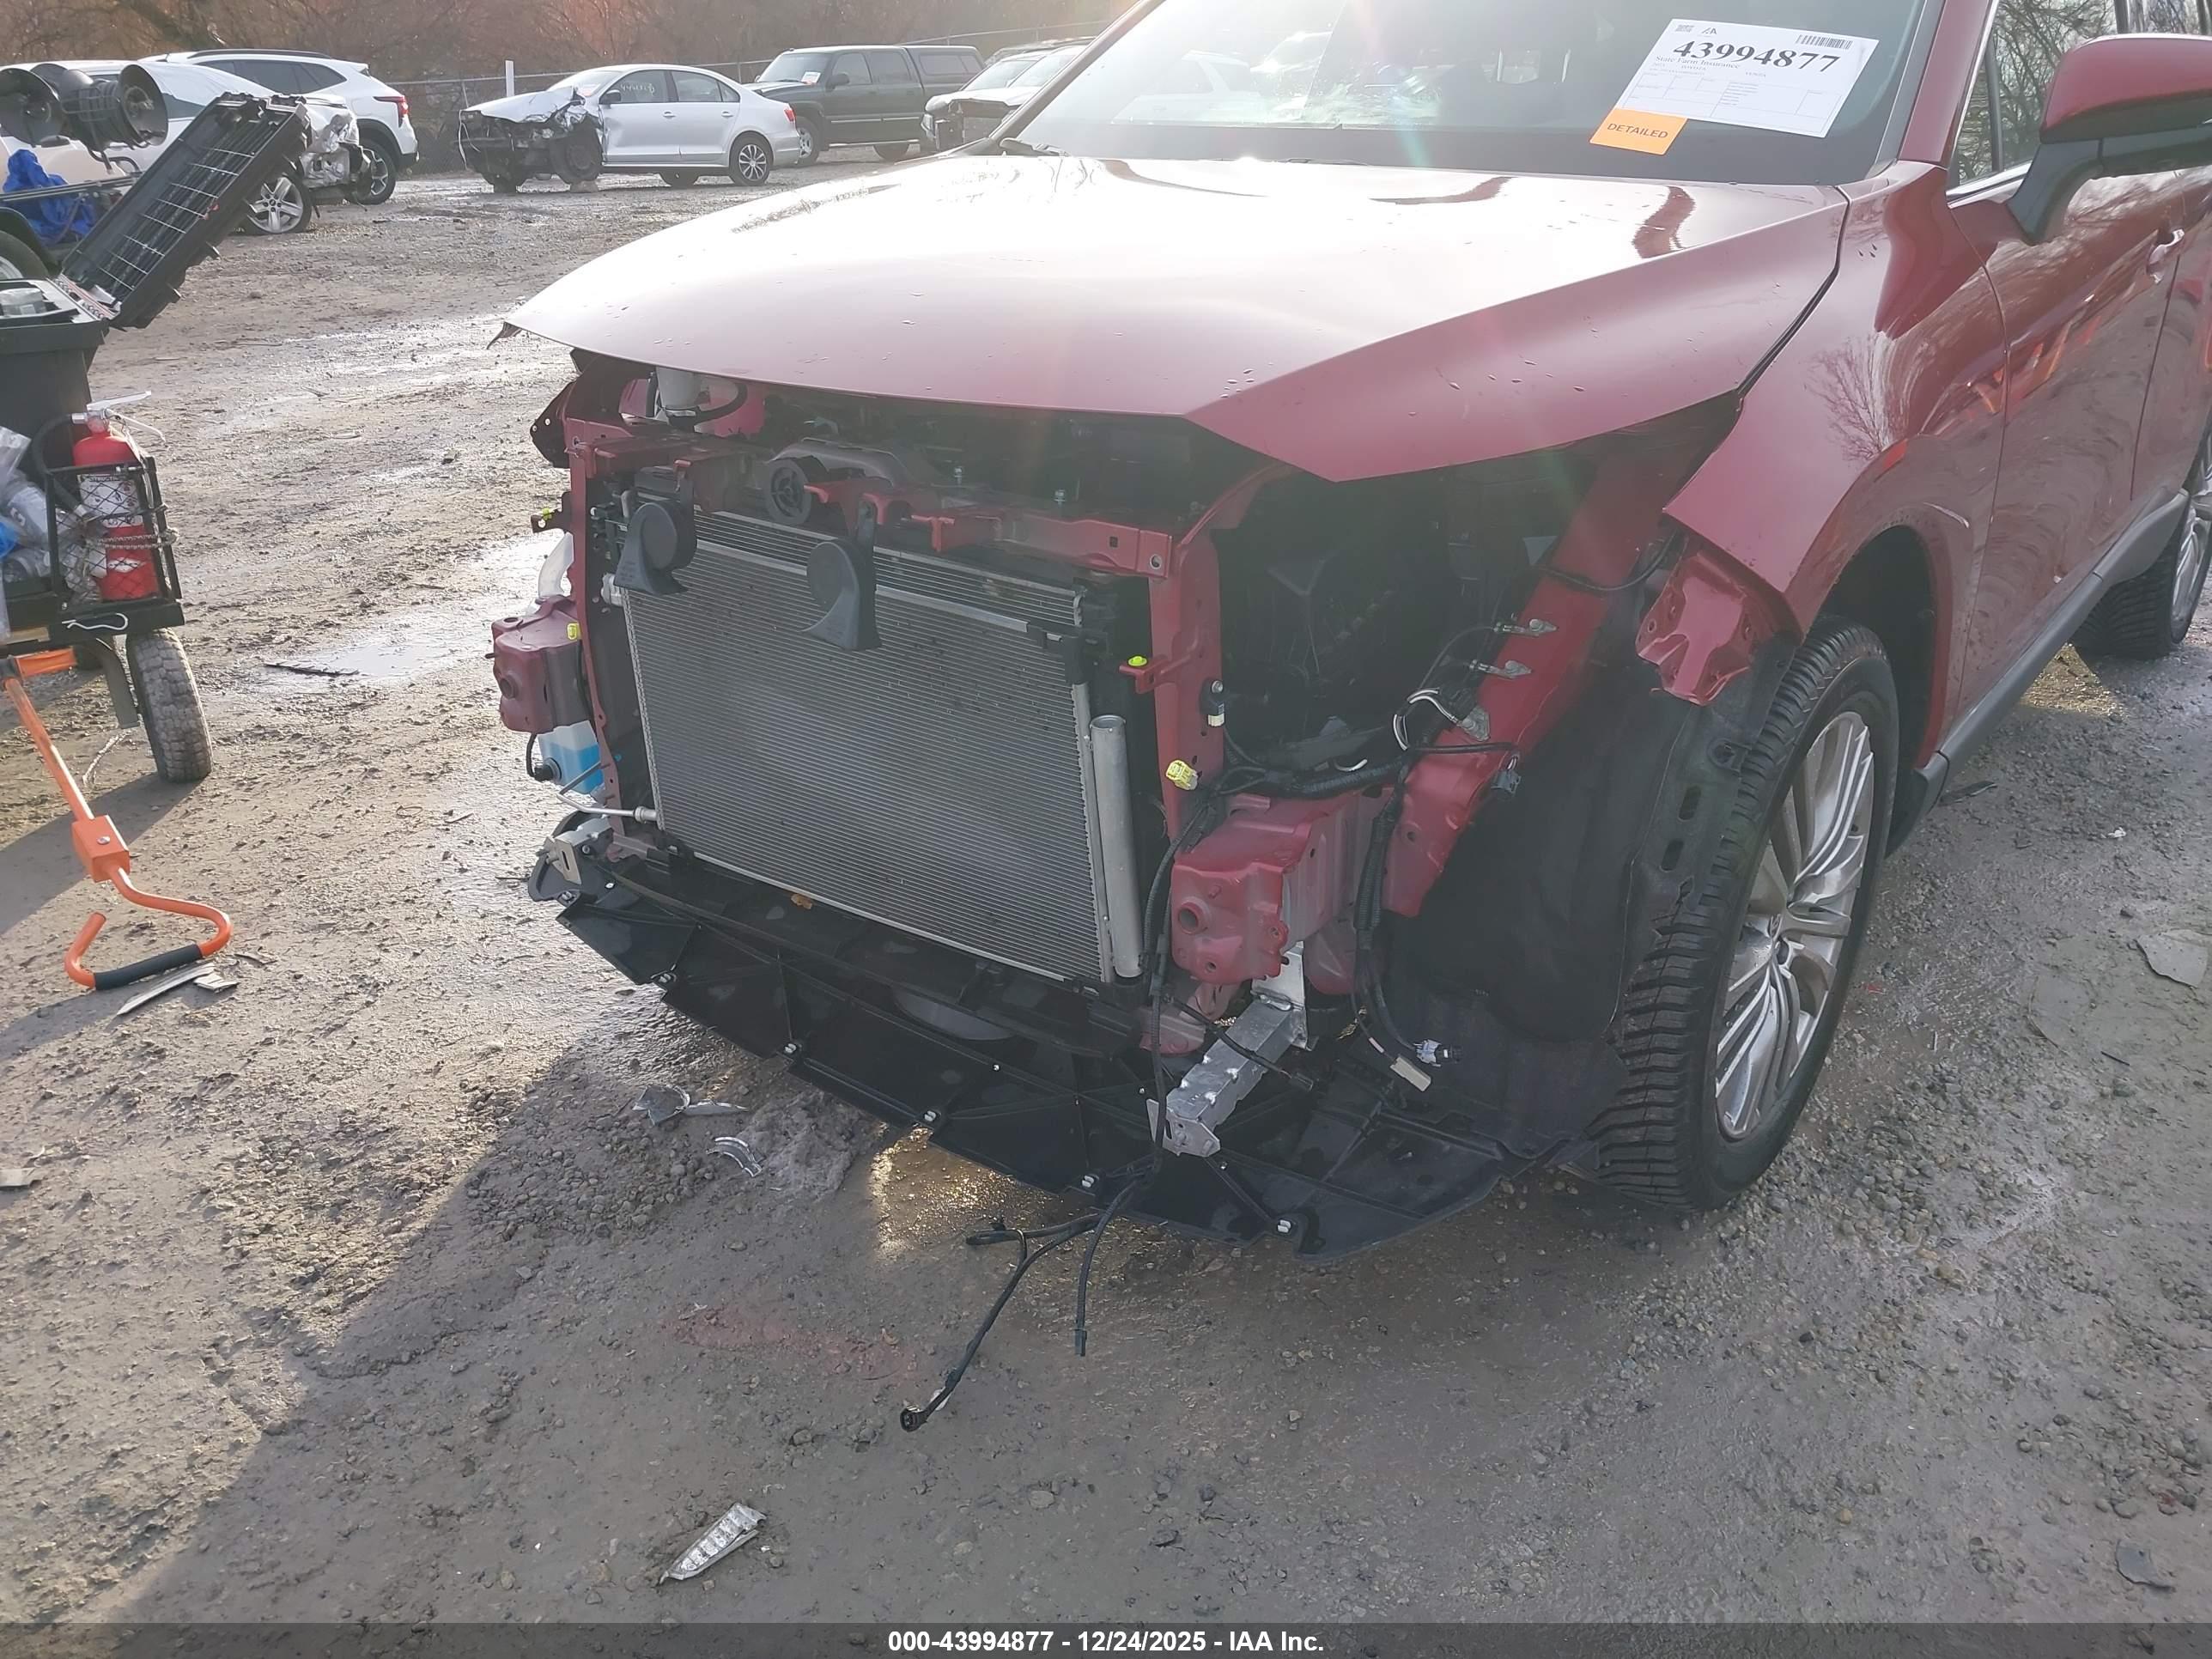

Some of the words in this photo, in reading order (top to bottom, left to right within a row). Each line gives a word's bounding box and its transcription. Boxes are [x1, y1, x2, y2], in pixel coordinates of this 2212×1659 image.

[1673, 40, 1841, 72] 43994877
[1700, 59, 1740, 69] Insurance
[1607, 123, 1668, 138] DETAILED
